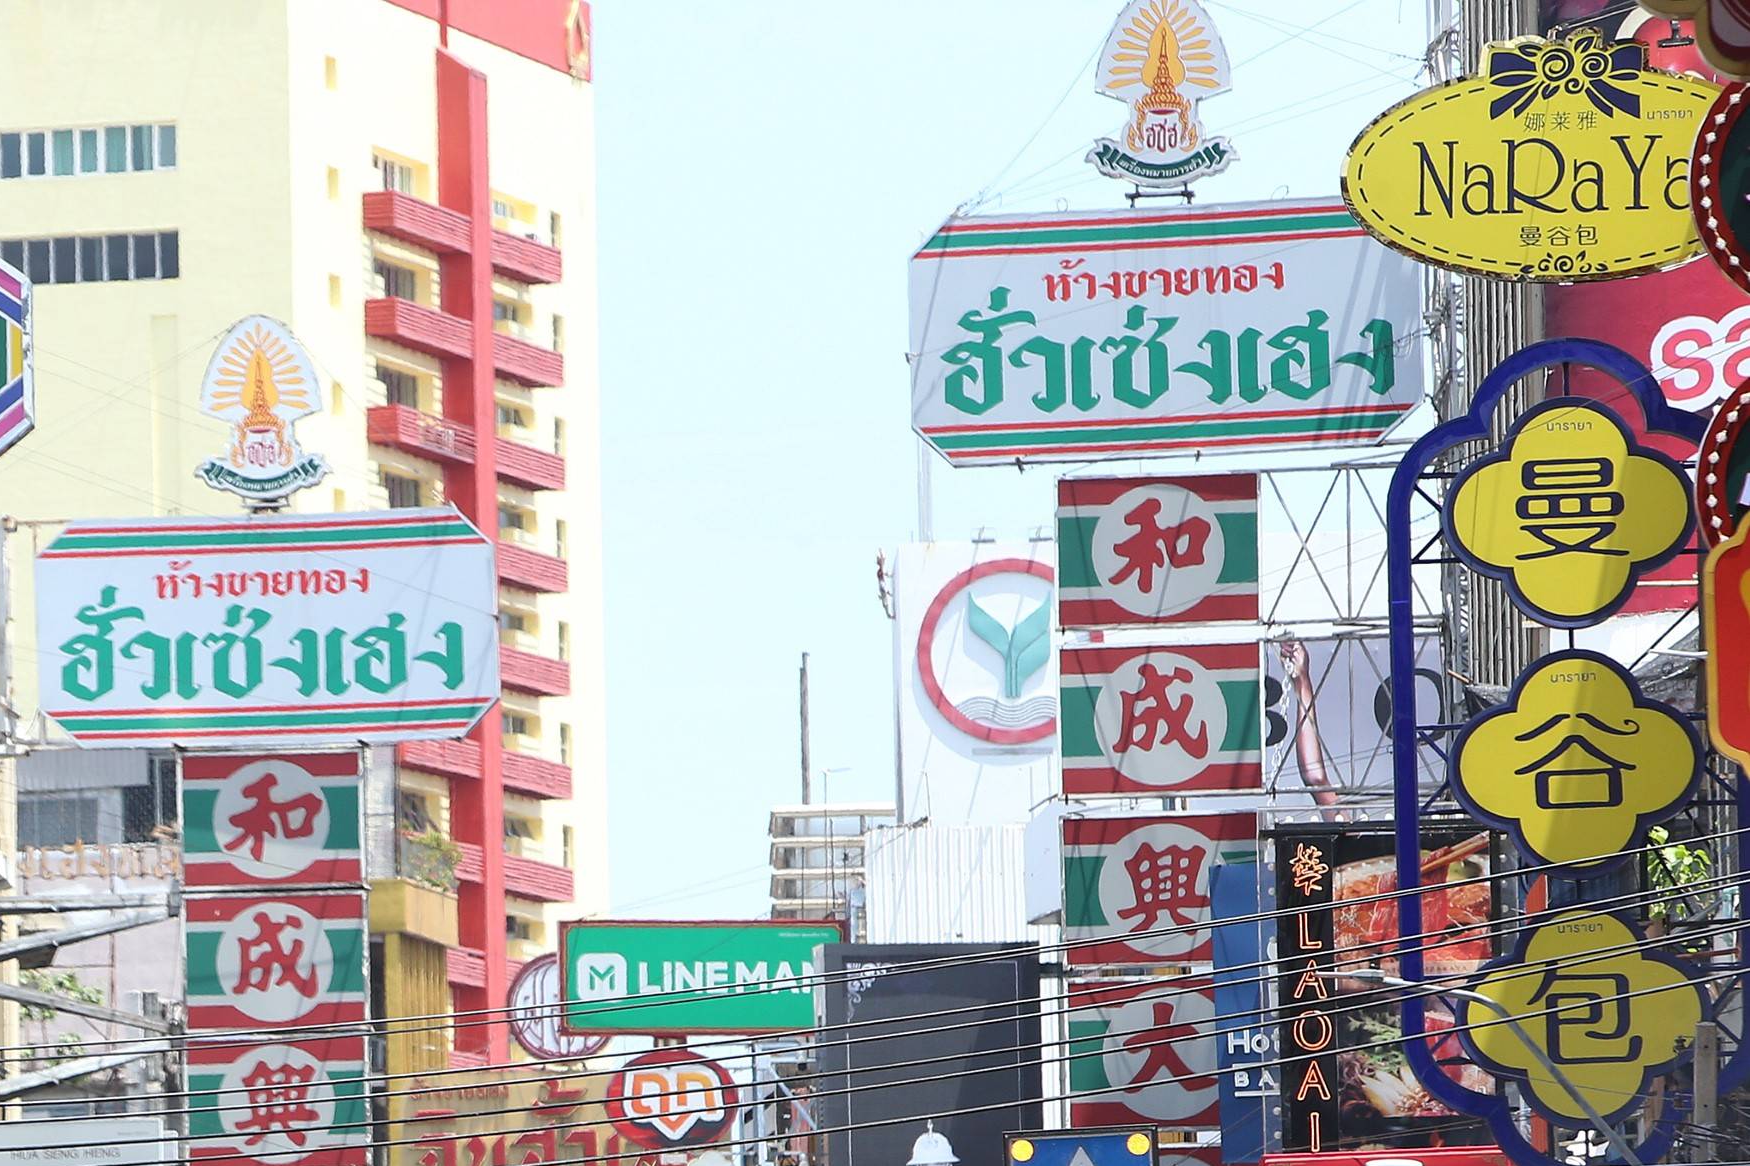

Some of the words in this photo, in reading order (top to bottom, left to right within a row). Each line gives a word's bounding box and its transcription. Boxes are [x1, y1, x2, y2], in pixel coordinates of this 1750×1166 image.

[1522, 111, 1598, 133] 娜莱雅
[1646, 110, 1694, 121] นารายา
[1519, 225, 1599, 247] 曼谷包
[1042, 258, 1286, 303] ห้างขายทอง
[940, 286, 1396, 416] ฮั่วเซ่งเฮง
[1546, 421, 1594, 432] นารายา
[155, 560, 370, 601] ห้างขายทอง
[58, 585, 464, 701] ฮั่วเซ่งเฮง
[1550, 672, 1597, 683] นารายา
[1557, 923, 1604, 934] นารายา
[638, 961, 730, 995] LINE
[43, 1147, 79, 1160] SENG
[84, 1146, 120, 1159] HENG
